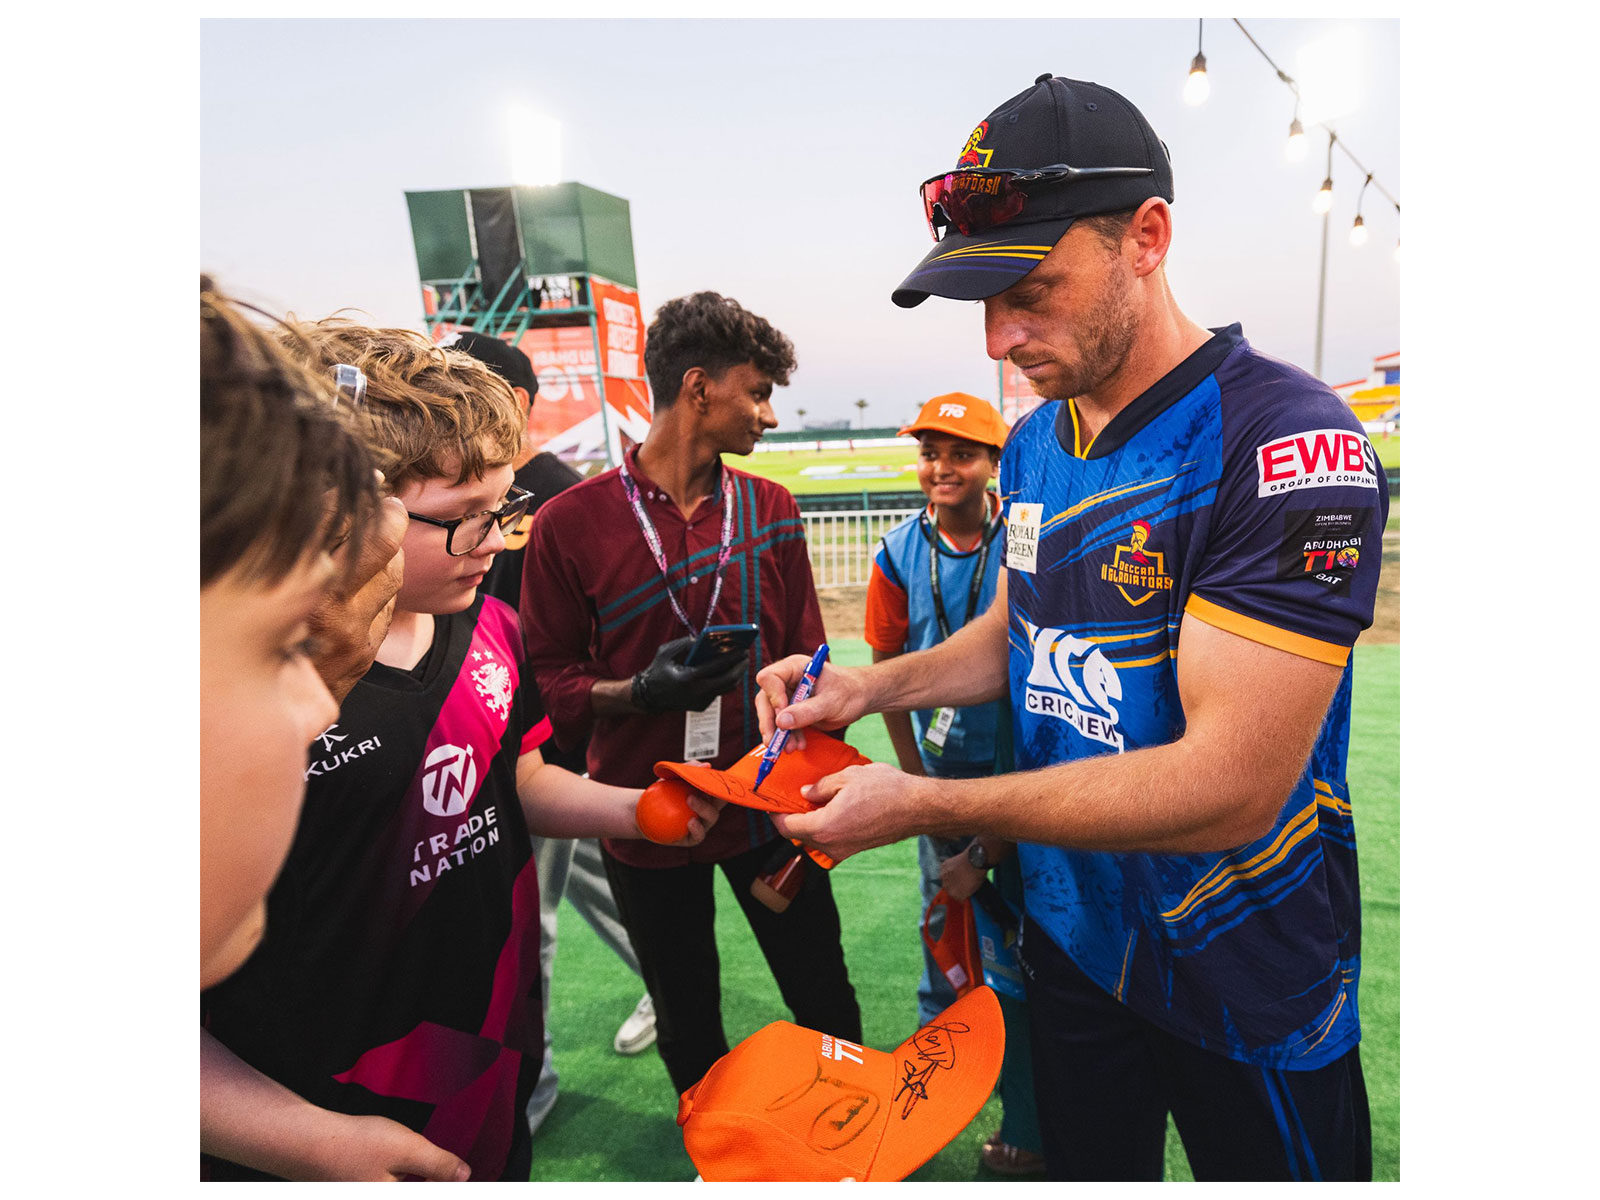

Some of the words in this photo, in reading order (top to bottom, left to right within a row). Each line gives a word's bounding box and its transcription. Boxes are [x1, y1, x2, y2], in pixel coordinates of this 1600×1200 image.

[1261, 434, 1377, 483] EWBS
[1270, 477, 1311, 492] GROUP
[1318, 476, 1331, 484] OF
[1316, 514, 1353, 522] ZIMBABWE
[1008, 523, 1037, 541] ROYAL
[1007, 538, 1035, 558] GREEN
[1303, 540, 1326, 550] ABU
[1326, 537, 1361, 549] DHABI
[1118, 560, 1155, 576] DECCAN
[303, 735, 382, 782] KUKRI
[413, 806, 497, 863] TRADE
[409, 826, 500, 887] NATION
